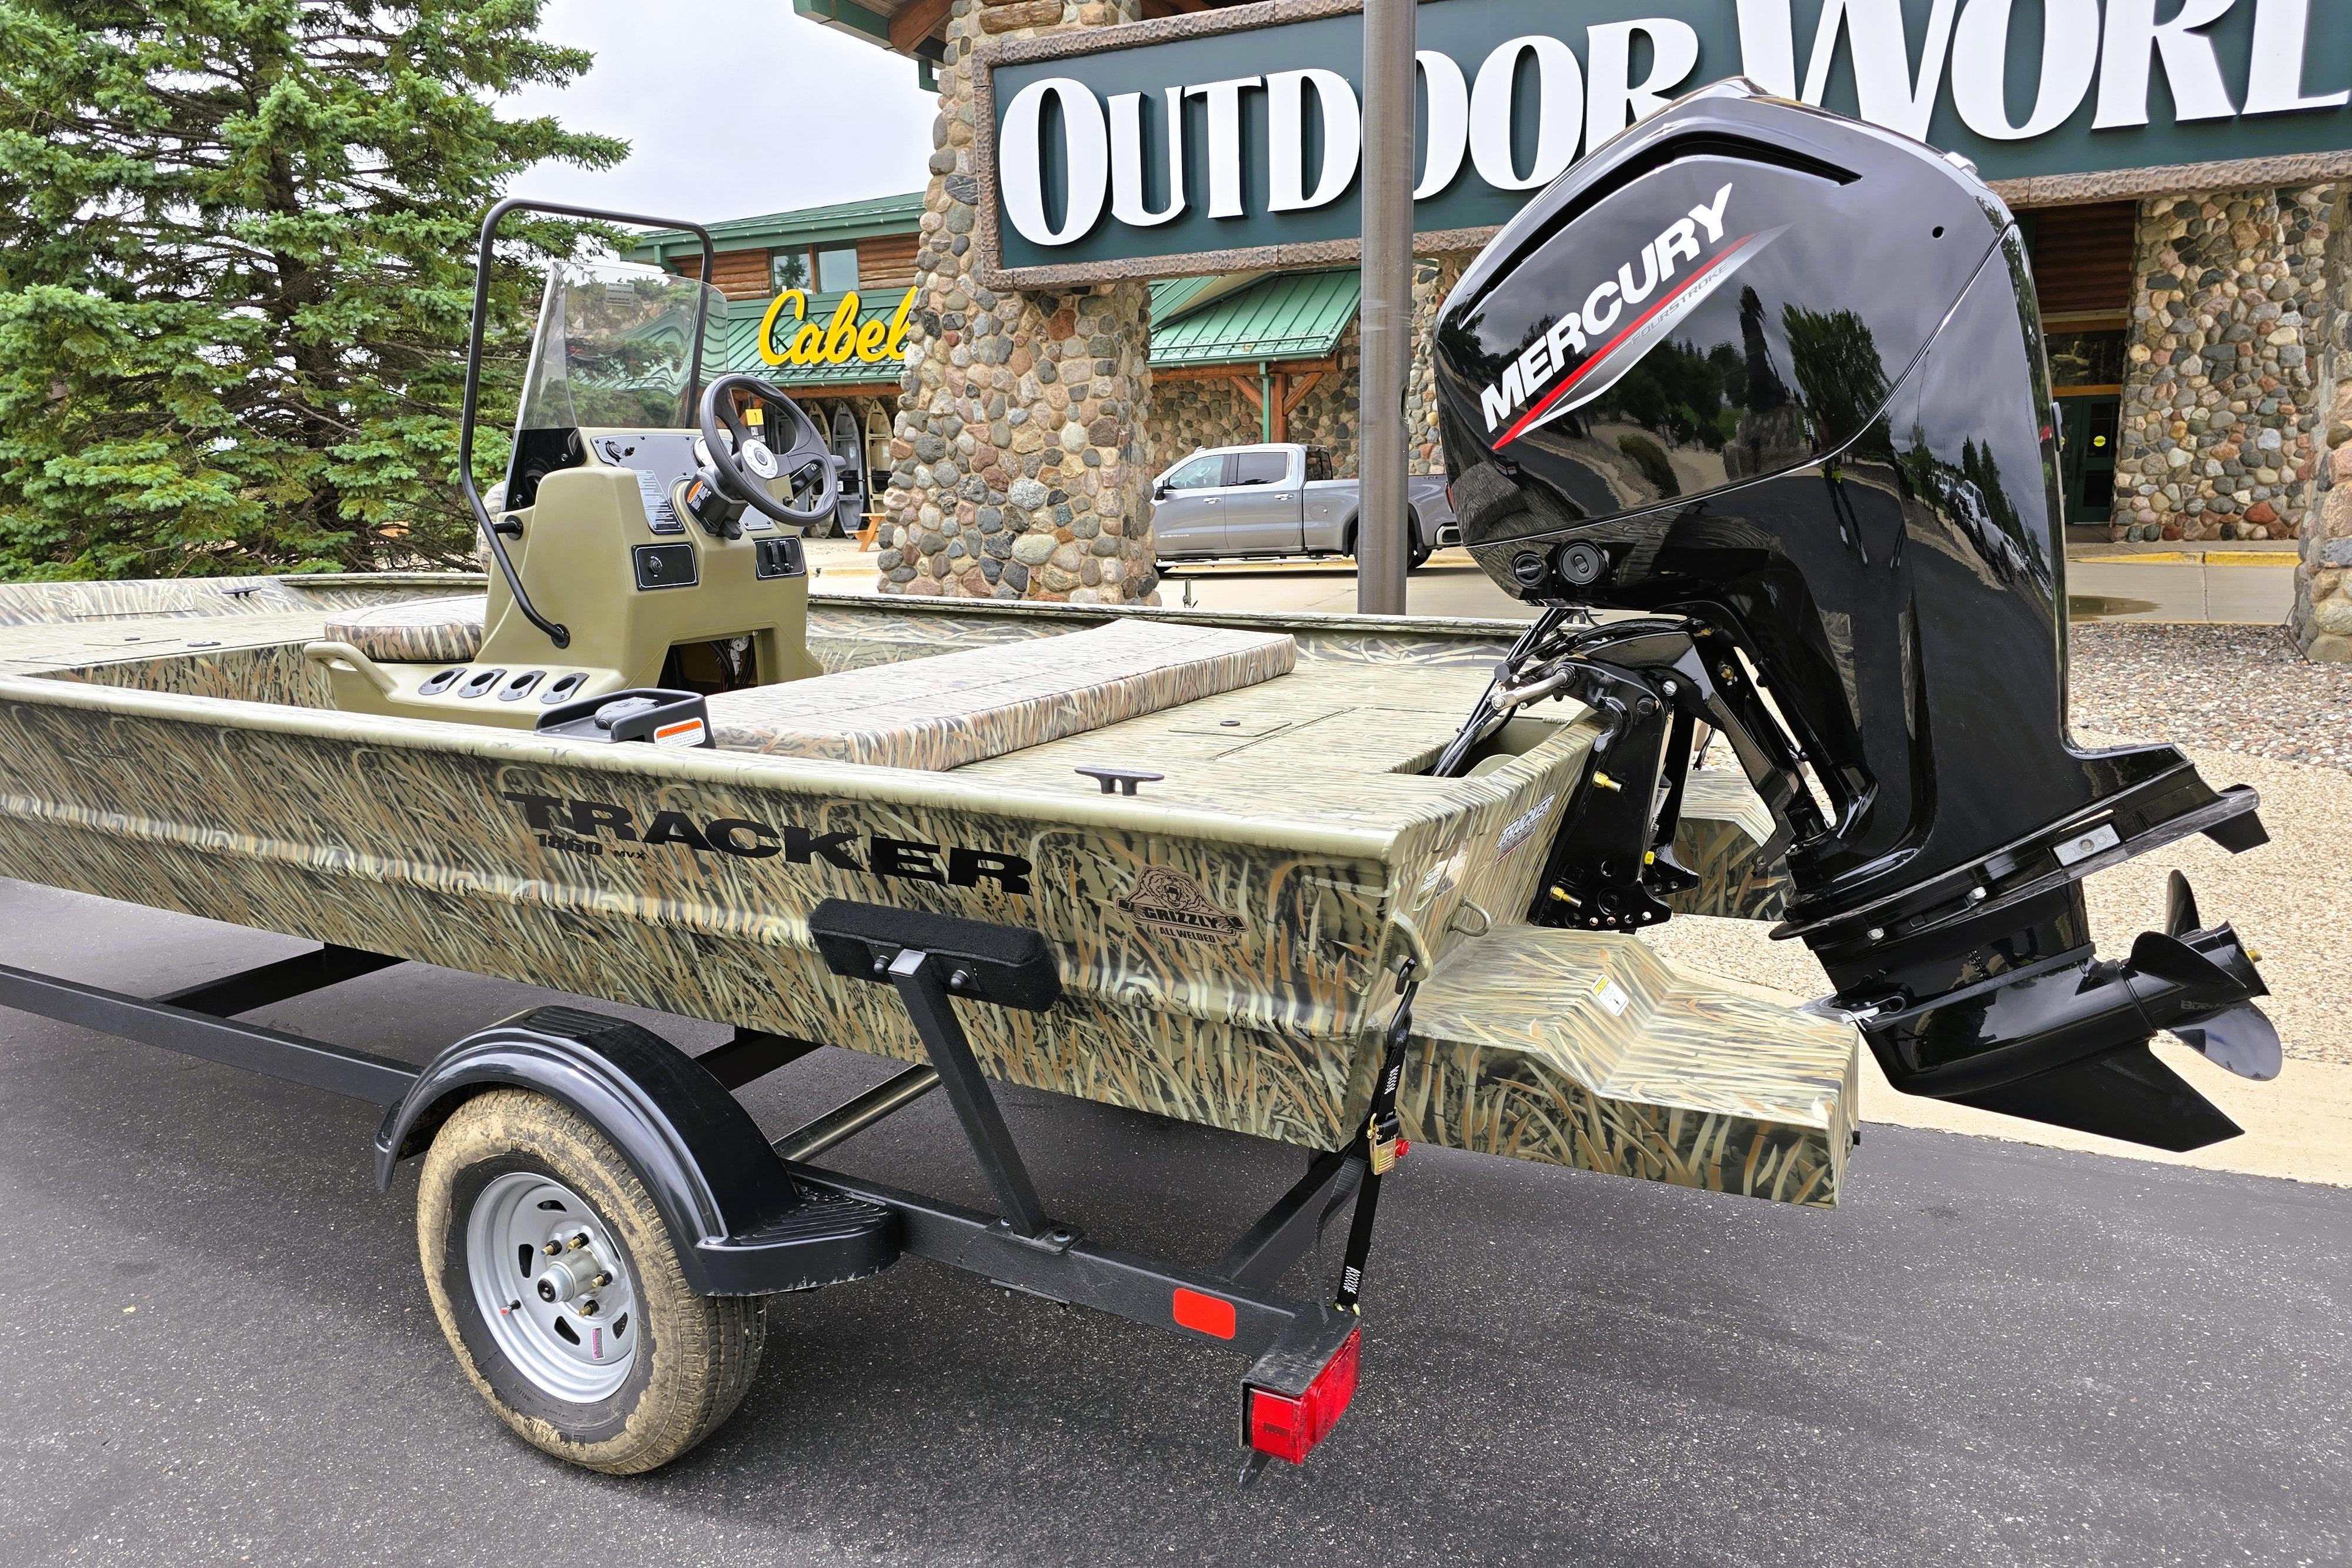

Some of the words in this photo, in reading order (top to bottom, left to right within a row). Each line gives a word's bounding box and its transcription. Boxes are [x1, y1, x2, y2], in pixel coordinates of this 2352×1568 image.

[1480, 182, 1732, 433] MERCURY
[1631, 262, 1728, 346] FOURSTROKE
[503, 791, 1033, 895] TRACKER
[534, 834, 603, 856] 1860
[613, 850, 646, 861] MVX
[1496, 792, 1556, 850] TRACKER
[1143, 906, 1222, 930] GRIZZLY
[1159, 927, 1176, 937] ALL
[1176, 928, 1217, 944] WELDED
